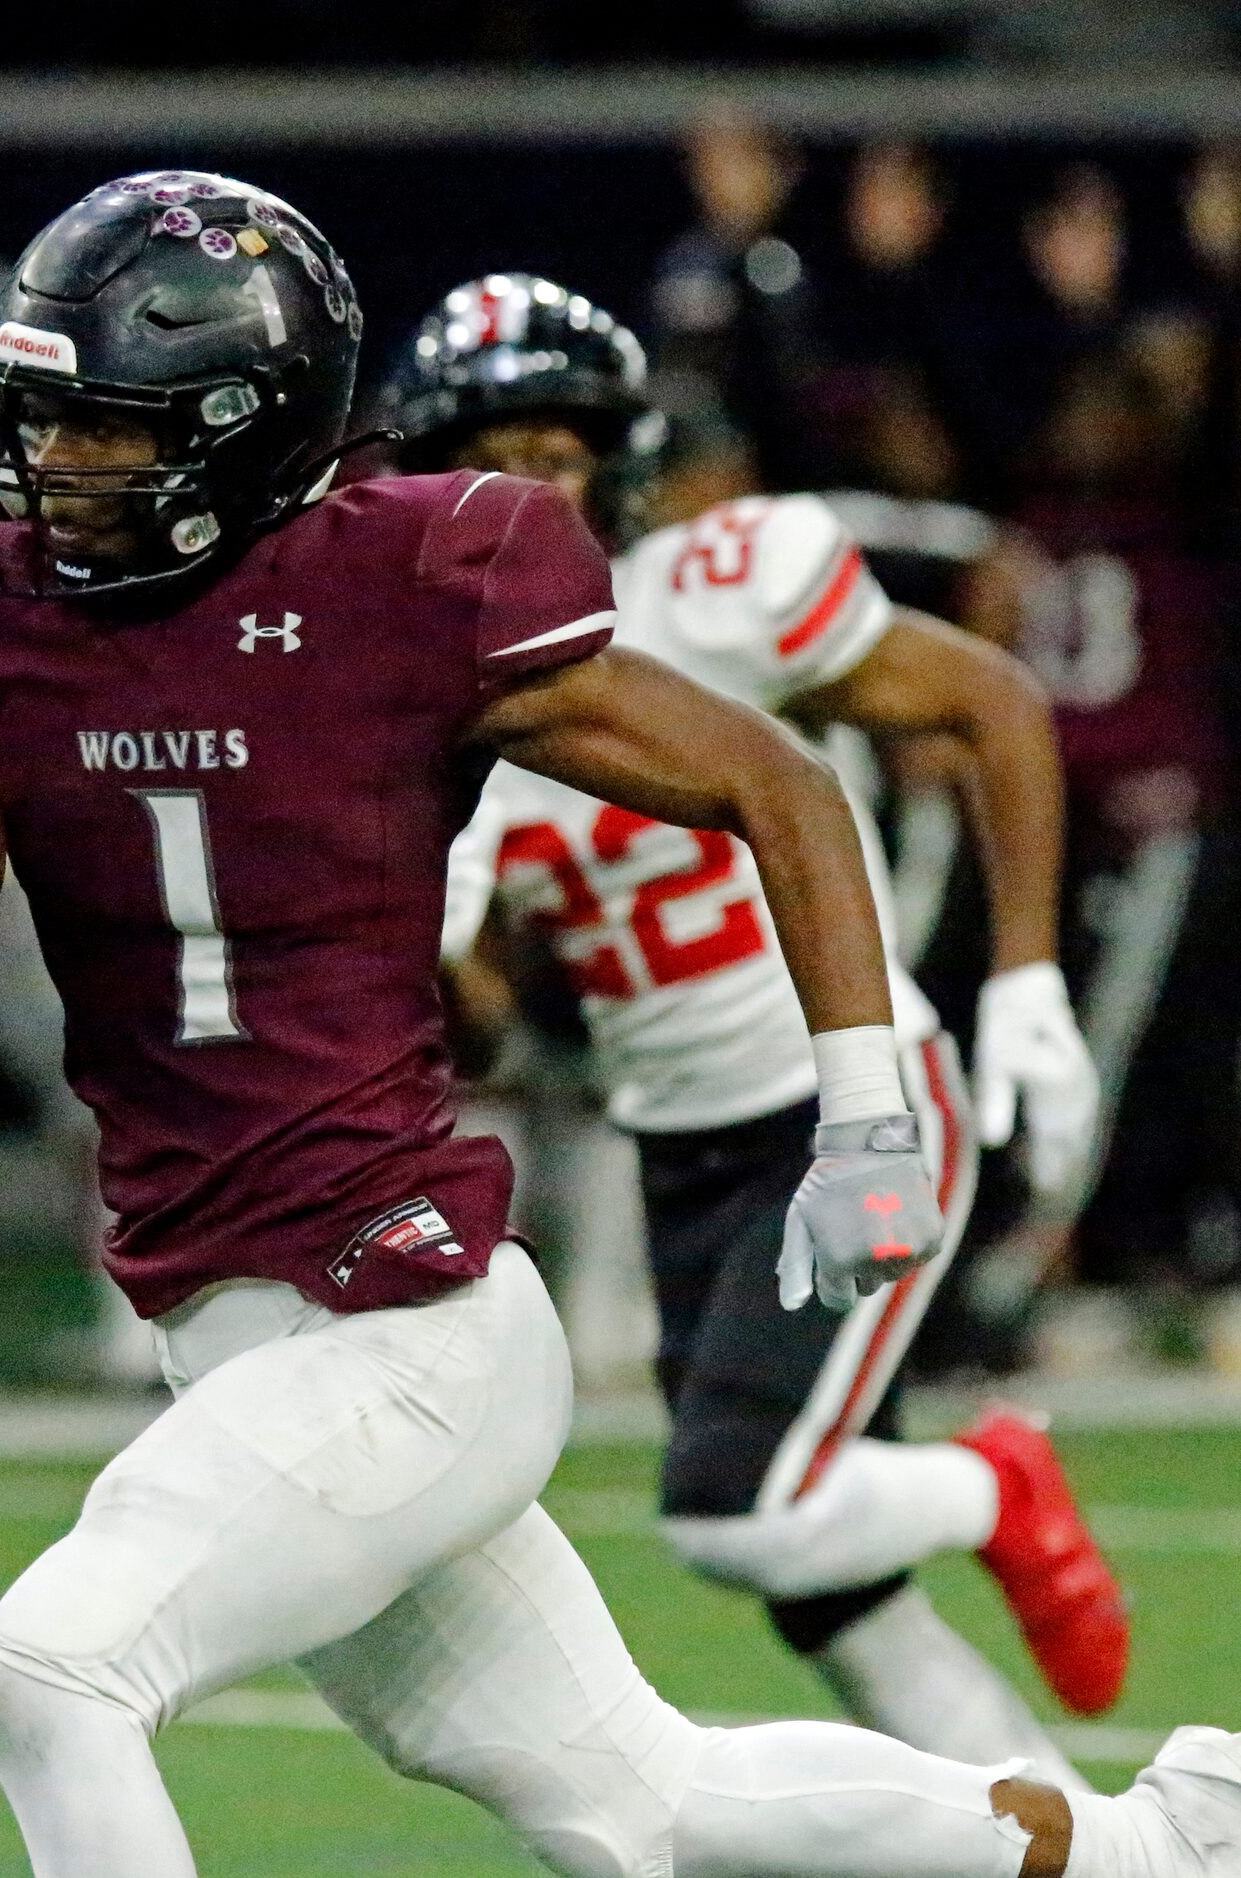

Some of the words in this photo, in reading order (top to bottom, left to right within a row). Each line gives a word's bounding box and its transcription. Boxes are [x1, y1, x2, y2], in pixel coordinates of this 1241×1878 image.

[242, 263, 287, 348] 1
[77, 728, 250, 772] WOLVES
[124, 788, 253, 1047] 1
[497, 804, 766, 1001] 22
[383, 1227, 419, 1247] THENTIC
[422, 1219, 440, 1230] MD
